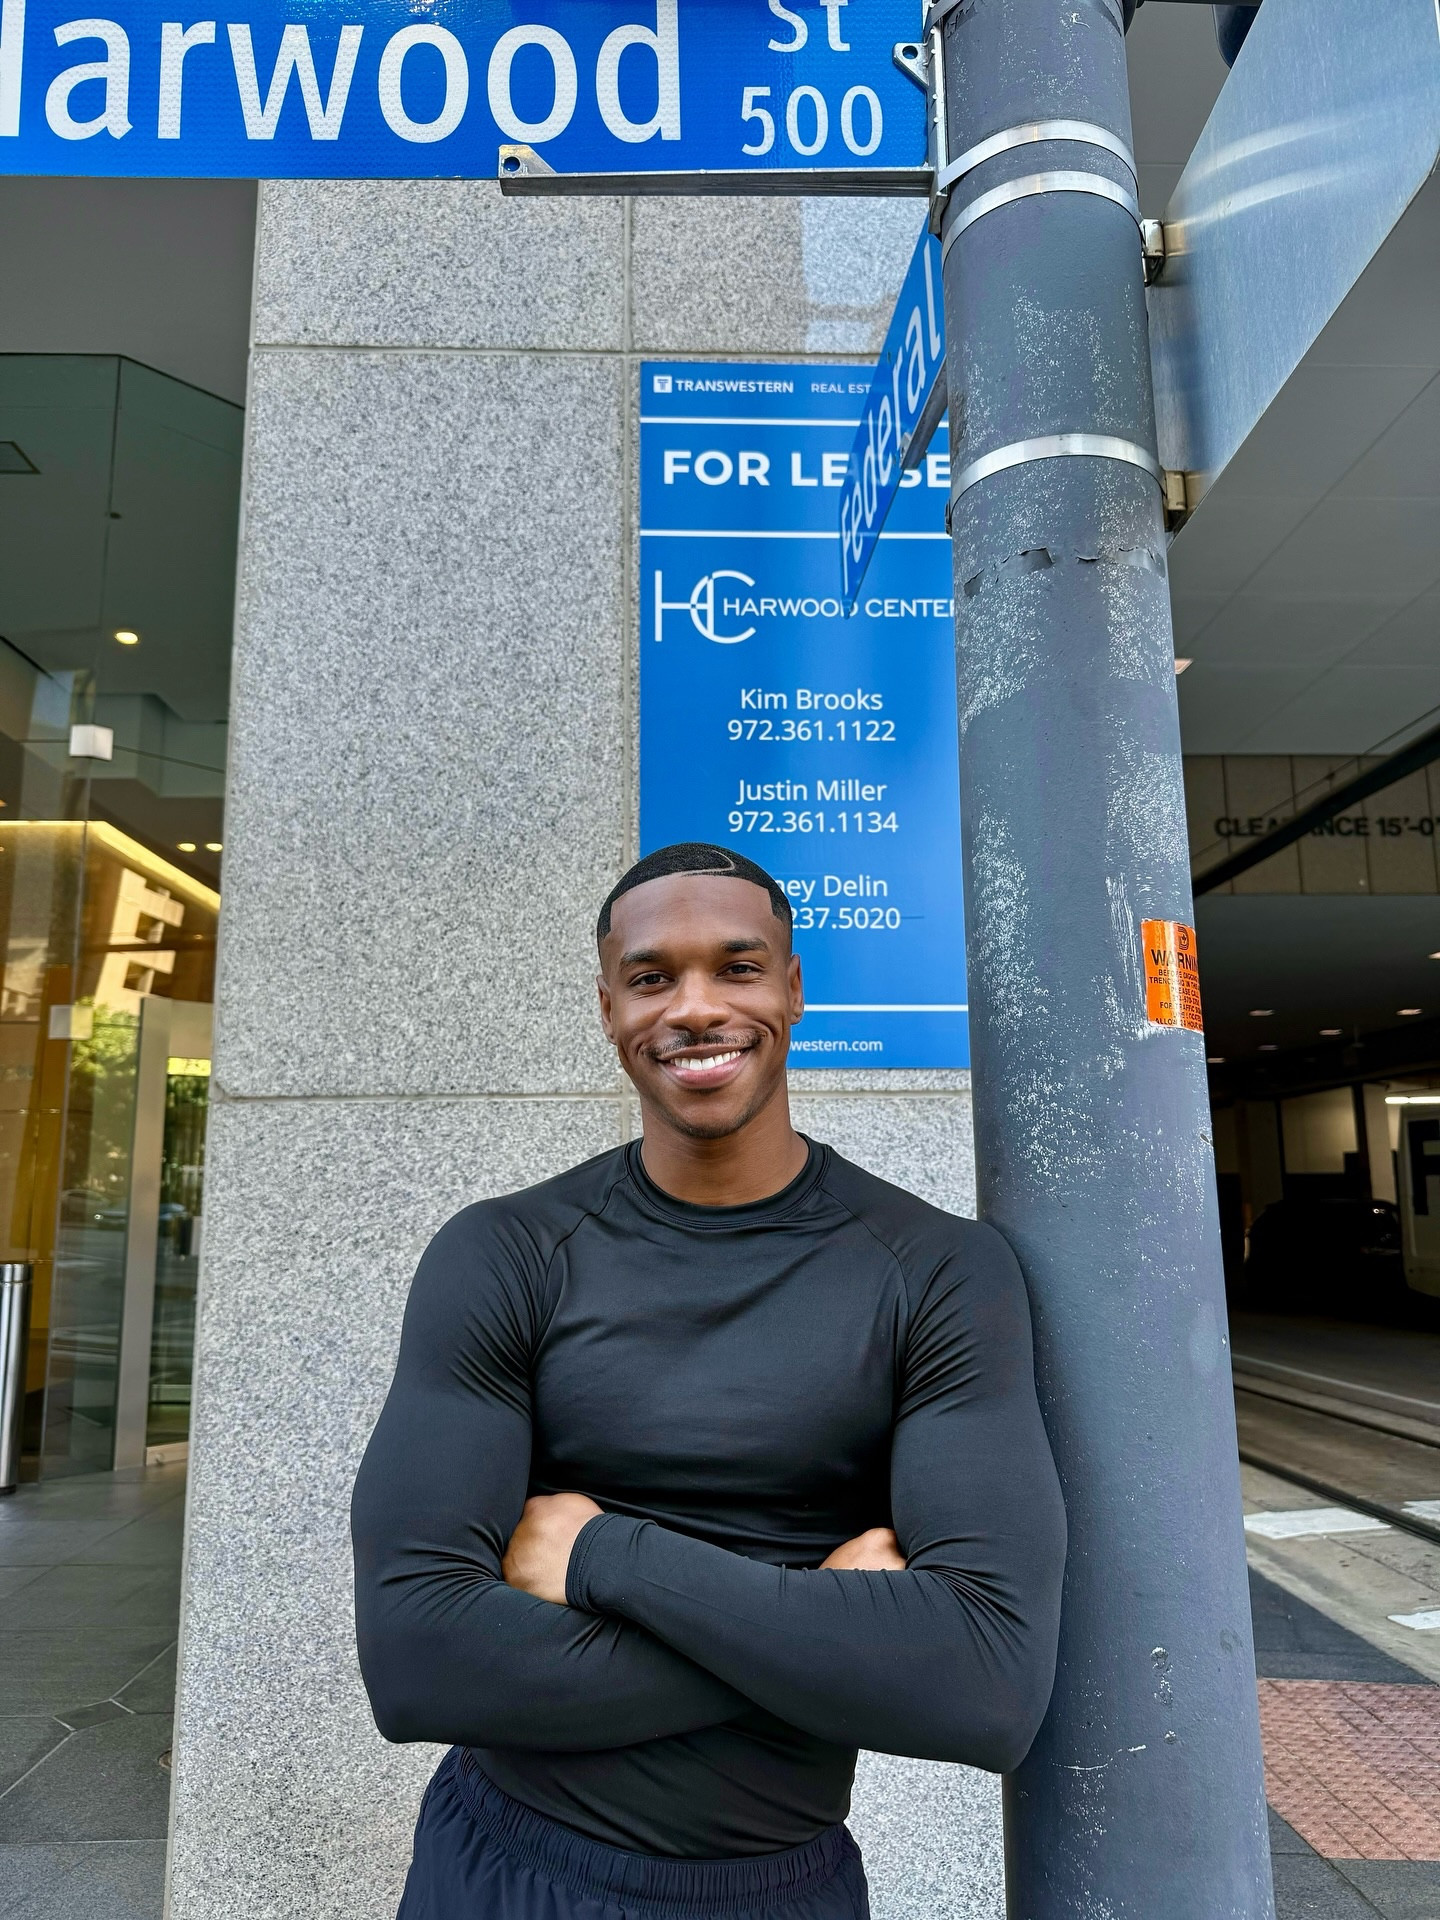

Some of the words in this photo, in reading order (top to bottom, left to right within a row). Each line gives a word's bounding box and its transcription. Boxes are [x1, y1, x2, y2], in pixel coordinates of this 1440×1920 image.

[767, 0, 850, 52] St
[0, 0, 681, 144] arwood
[741, 85, 883, 156] 500
[675, 379, 794, 393] TRANSWESTERN
[811, 383, 844, 394] REAL
[849, 383, 872, 394] EST
[841, 239, 941, 595] Federal
[664, 451, 770, 486] FOR
[741, 689, 787, 710] Kim
[796, 688, 883, 710] Brooks
[727, 720, 896, 741] 972.361.1122
[736, 779, 808, 805] Justin
[817, 779, 887, 801] Miller
[728, 811, 899, 833] 972.361.1134
[824, 874, 888, 897] Delin
[791, 907, 900, 929] 237.5020
[790, 1039, 883, 1052] western.com
